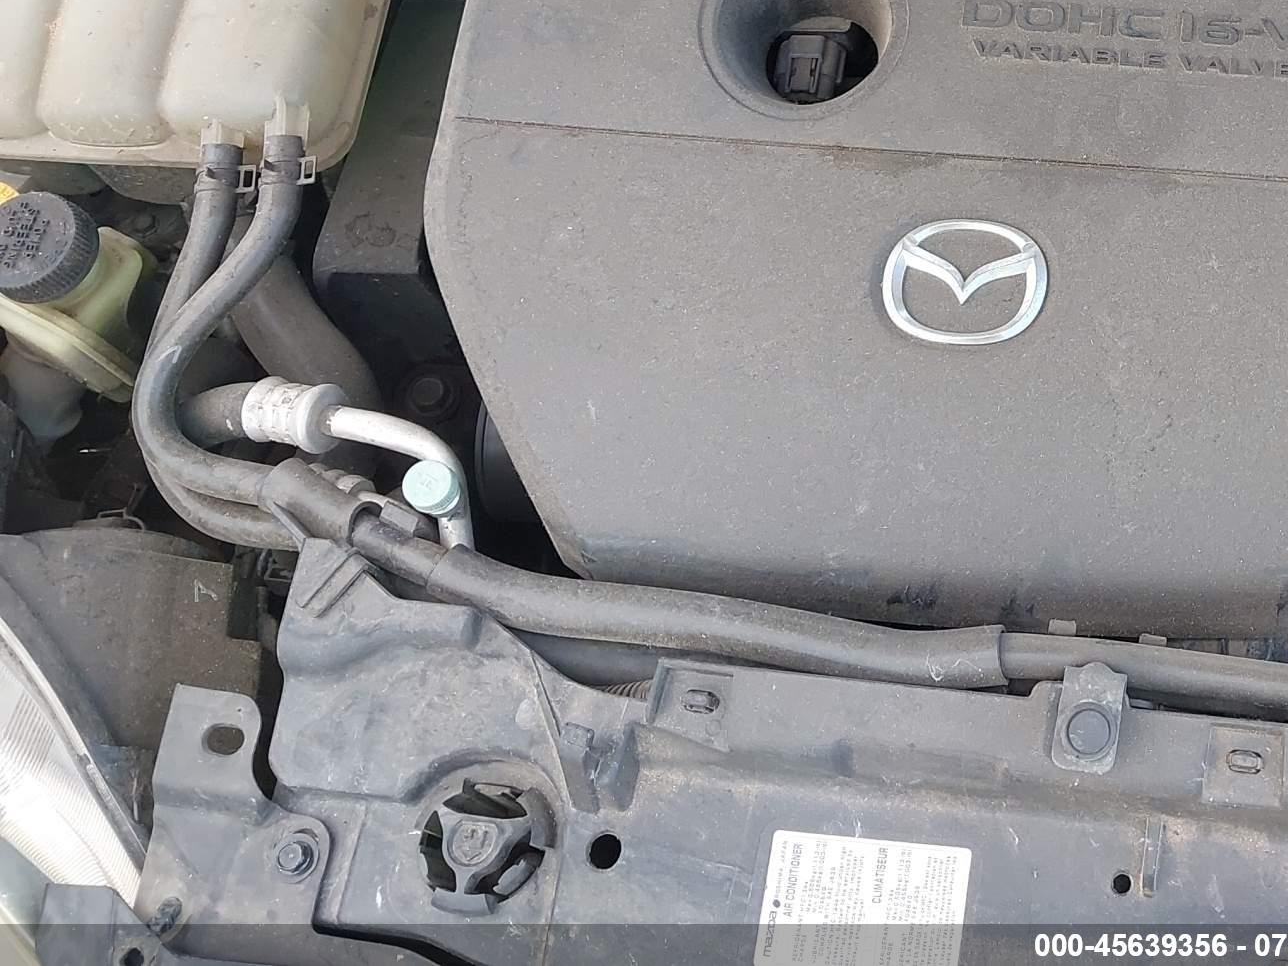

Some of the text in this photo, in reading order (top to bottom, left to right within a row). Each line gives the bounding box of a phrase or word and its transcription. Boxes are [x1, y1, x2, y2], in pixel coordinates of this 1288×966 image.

[970, 37, 1168, 71] VARIABLE
[783, 843, 803, 917] AIR CONDITIONER
[872, 847, 889, 903] CLIMATISEUR
[763, 911, 777, 957] mazda
